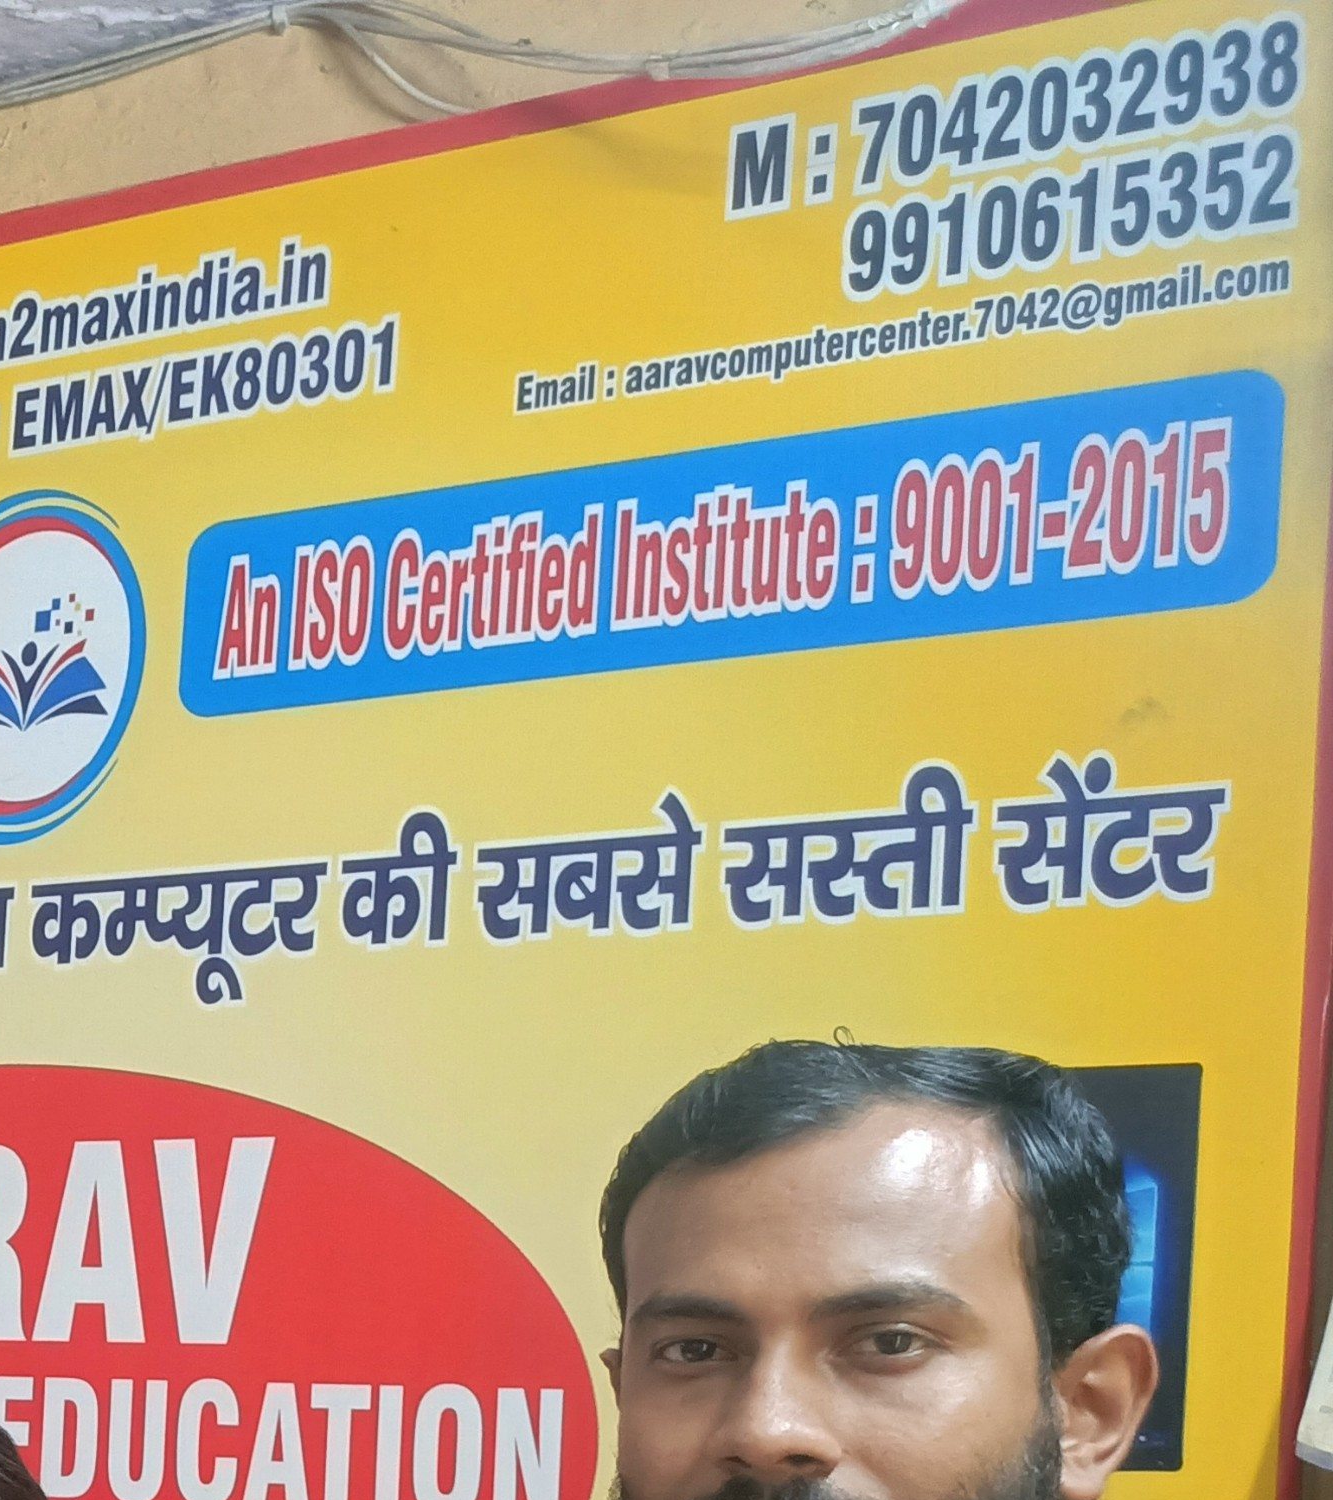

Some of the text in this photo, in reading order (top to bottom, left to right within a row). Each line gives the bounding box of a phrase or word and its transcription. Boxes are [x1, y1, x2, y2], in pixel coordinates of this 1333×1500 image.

[731, 127, 788, 211] M
[858, 20, 1299, 189] 7042032938
[850, 138, 1292, 293] 9910615352
[12, 322, 396, 450] EMAX/EK80301
[516, 370, 594, 412] Email
[625, 260, 1288, 396] aaravcomputercenter.7042@gmail.com
[219, 562, 277, 672] An
[291, 540, 370, 668] ISO
[389, 508, 594, 655] Certified
[615, 488, 836, 632] Institute
[893, 422, 1228, 594] 9001-2015
[31, 863, 327, 1002] कम्प्यूटर
[344, 812, 456, 946] की
[478, 796, 702, 940] सबसे
[725, 767, 970, 922] सस्ती
[995, 753, 1229, 903] सेंटर
